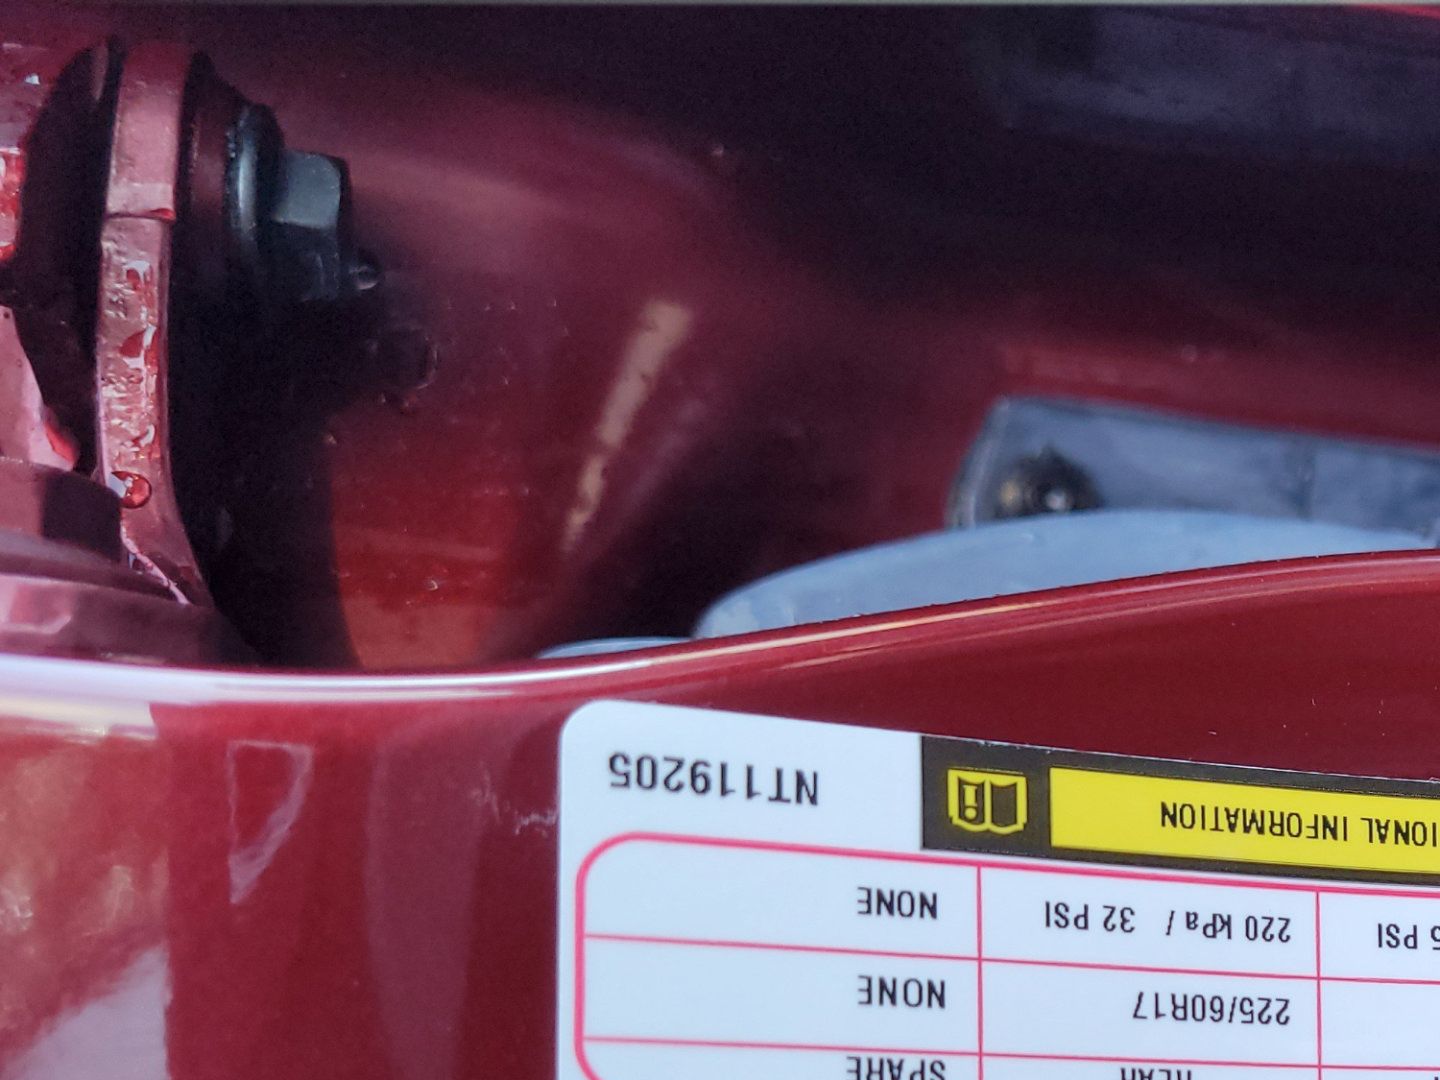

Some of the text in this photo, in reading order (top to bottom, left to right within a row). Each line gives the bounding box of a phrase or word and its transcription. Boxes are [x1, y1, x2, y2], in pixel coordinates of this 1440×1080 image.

[609, 753, 818, 806] NT119205
[1160, 801, 1348, 842] INFORMATION
[857, 886, 938, 920] NONE
[1045, 901, 1089, 930] PSI
[1102, 905, 1135, 933] 32
[1245, 915, 1291, 943] 220
[1377, 923, 1418, 950] PSI
[858, 976, 946, 1009] NONE
[1132, 991, 1290, 1026] 225/60R17
